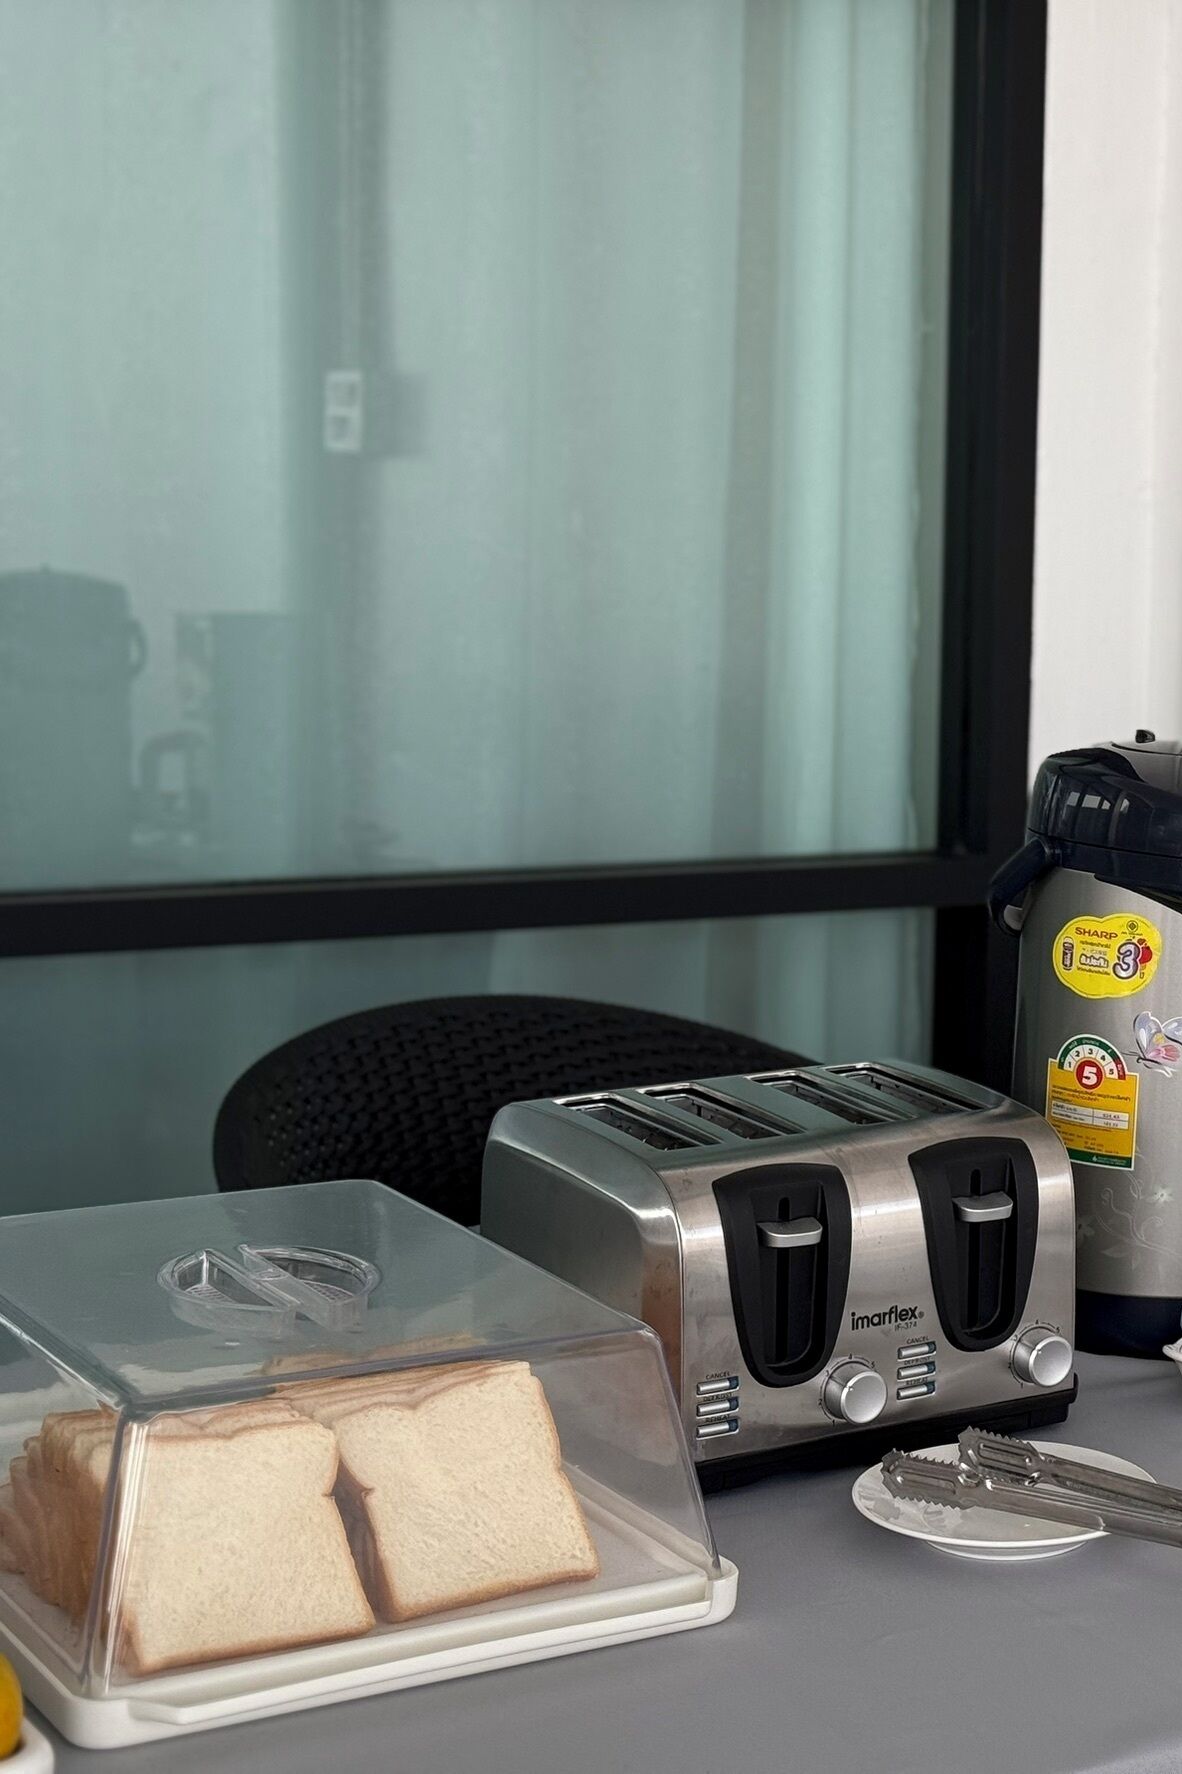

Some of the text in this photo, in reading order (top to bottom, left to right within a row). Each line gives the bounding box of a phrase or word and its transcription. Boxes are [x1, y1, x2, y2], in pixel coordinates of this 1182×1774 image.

[1075, 927, 1118, 940] SHARP
[1112, 941, 1141, 980] 3
[1075, 1050, 1080, 1058] 2
[1082, 1065, 1098, 1086] 5
[851, 1305, 918, 1331] imarflex
[906, 1335, 929, 1344] CANCEL
[705, 1371, 730, 1380] CANCEL
